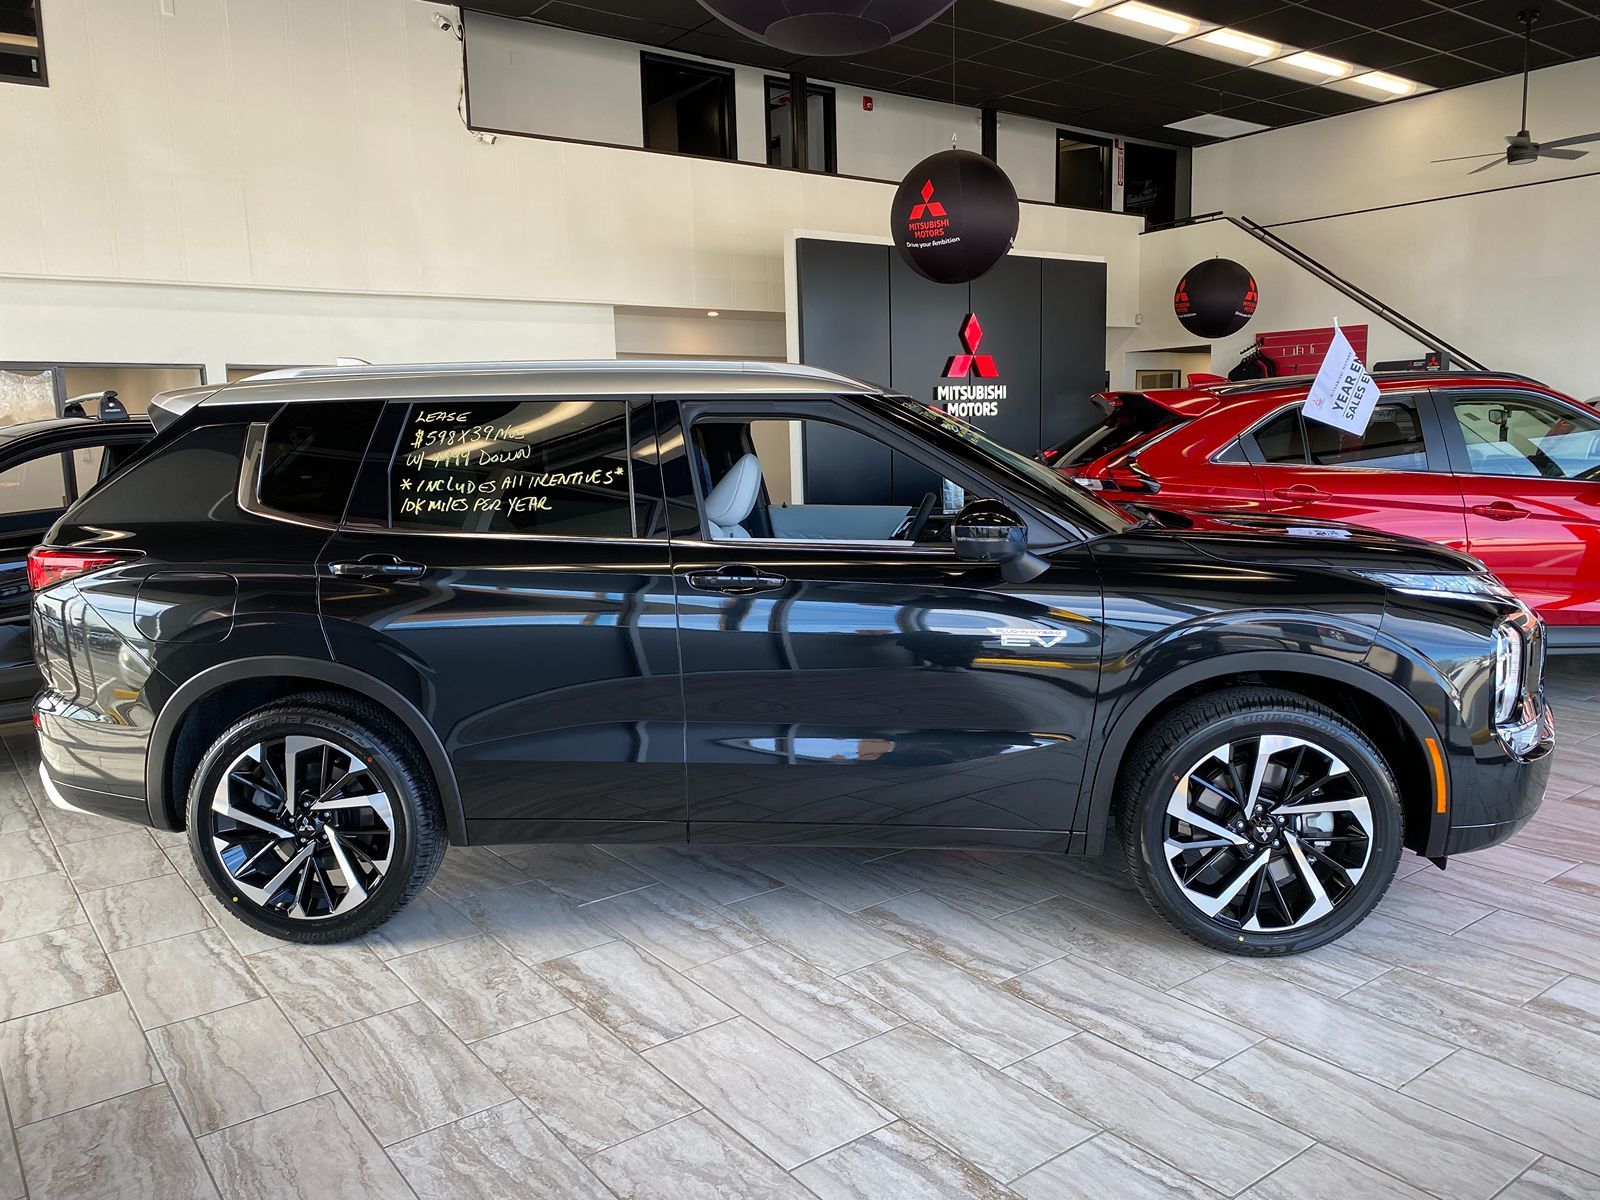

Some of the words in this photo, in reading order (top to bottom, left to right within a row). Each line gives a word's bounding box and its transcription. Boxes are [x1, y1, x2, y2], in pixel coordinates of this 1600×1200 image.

[908, 219, 950, 231] MITSUBISHI
[914, 228, 945, 239] MOTORS
[932, 237, 961, 247] Ambition
[937, 385, 1007, 400] MITSUBISHI
[1332, 375, 1357, 410] YEAR
[947, 402, 998, 417] MOTORS
[1345, 386, 1366, 420] SALES
[415, 411, 472, 423] LEASE
[473, 498, 502, 512] PER
[506, 497, 553, 517] YEAR
